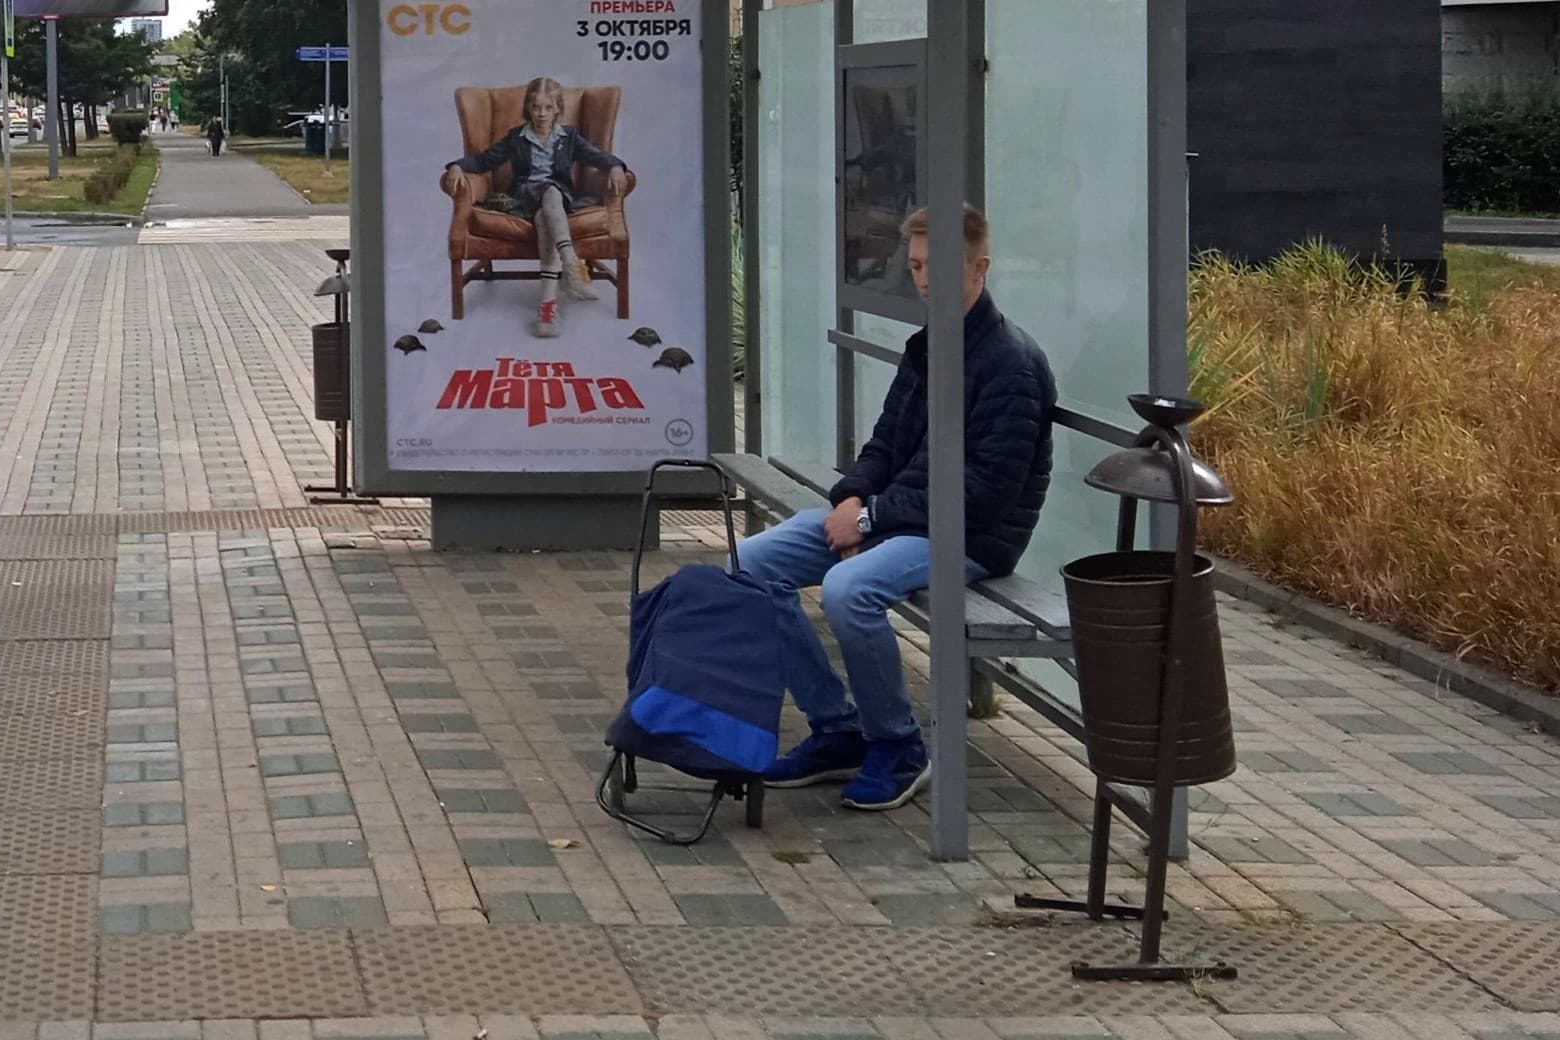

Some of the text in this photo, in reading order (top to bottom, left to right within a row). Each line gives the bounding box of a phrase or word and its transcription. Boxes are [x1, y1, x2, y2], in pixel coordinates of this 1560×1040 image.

[590, 0, 675, 14] ПРЕМЬЕРА
[387, 3, 472, 36] СТС
[576, 19, 691, 37] 3 ОКТЯБРЯ
[598, 40, 670, 61] 19:00
[496, 358, 575, 378] Тётя
[436, 370, 646, 427] Марта
[551, 416, 651, 425] КОМЕДИЙНЫЙ СЕРИАЛ
[669, 427, 690, 438] 16+
